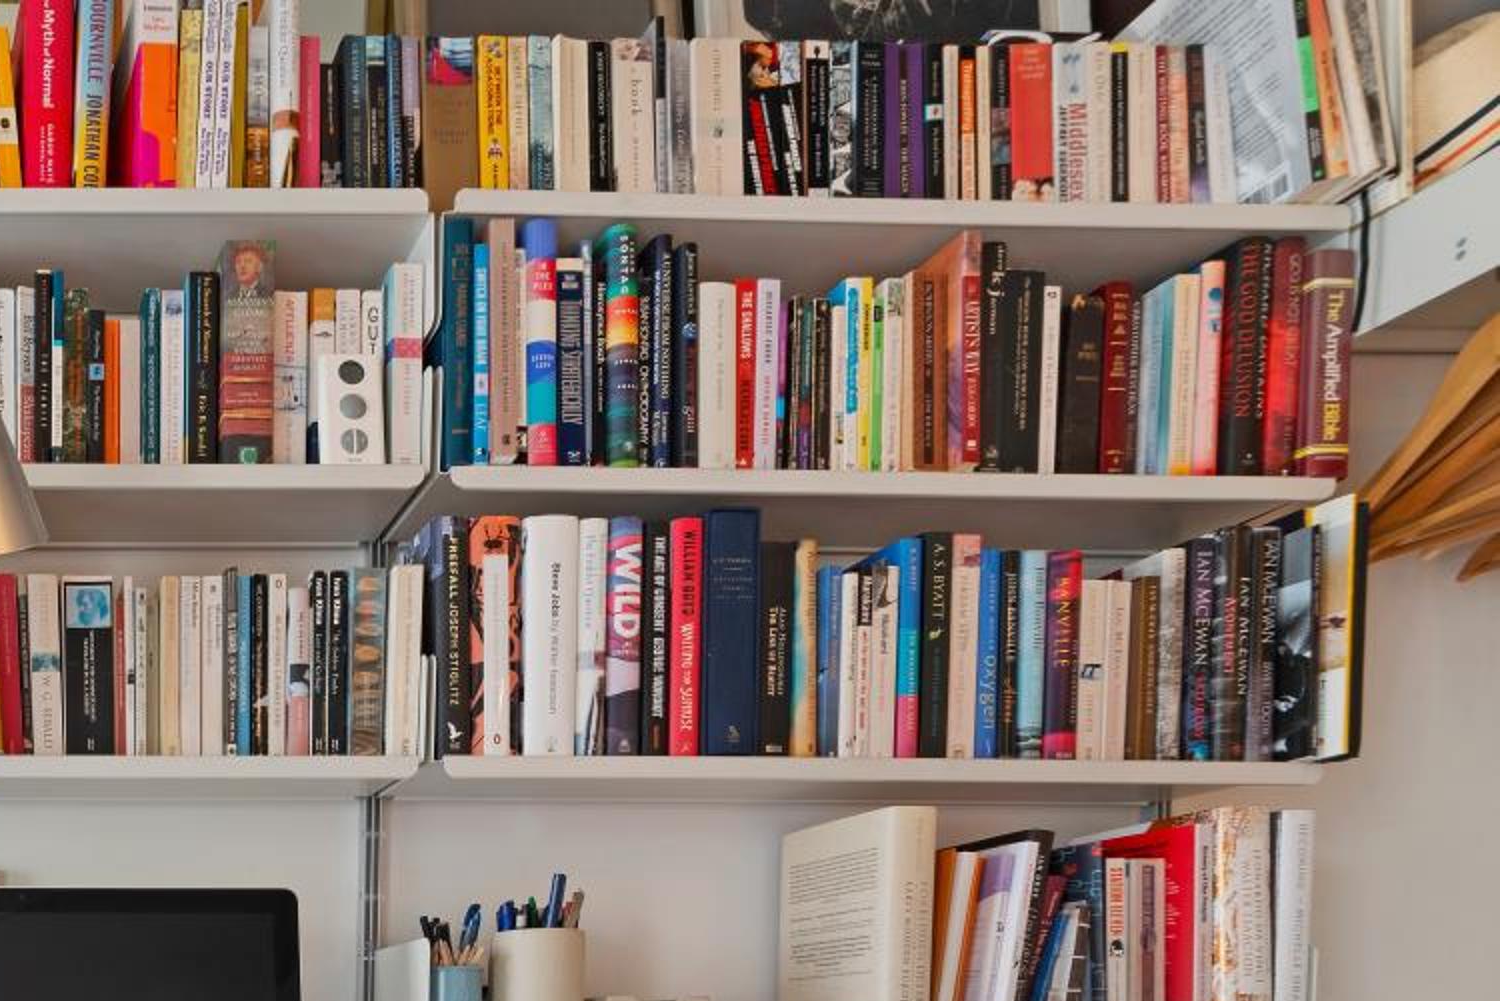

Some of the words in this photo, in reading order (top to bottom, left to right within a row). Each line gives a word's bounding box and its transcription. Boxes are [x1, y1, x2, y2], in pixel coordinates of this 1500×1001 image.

[41, 9, 56, 48] Myth
[42, 58, 55, 108] Normal
[83, 94, 103, 160] JONATHAN
[1058, 106, 1069, 148] JEFFREY
[1067, 103, 1088, 201] Middlesex
[619, 235, 630, 295] SONTAG
[1242, 243, 1259, 278] THE
[203, 289, 212, 316] Search
[476, 268, 487, 300] SWITCH
[661, 262, 672, 319] UNIVERSE
[741, 291, 753, 308] THE
[1239, 283, 1258, 321] GOD
[476, 302, 487, 313] ON
[560, 300, 582, 349] THINKING
[640, 296, 650, 323] SUSAN
[1326, 289, 1344, 321] The
[368, 307, 379, 354] GUT
[476, 315, 487, 337] YOUR
[640, 326, 650, 360] SONTAG
[661, 319, 672, 347] FROM
[739, 311, 752, 359] SHALLOWS
[476, 339, 487, 366] BRAIN
[1322, 324, 1343, 401] Amplified
[560, 350, 583, 425] STRATEGICALLY
[639, 366, 649, 383] ON
[661, 348, 671, 399] NOTHING
[1235, 329, 1256, 418] DELUSION
[639, 386, 649, 445] PHOTOGRAPHY
[1323, 402, 1341, 441] Bible
[655, 536, 666, 553] THE
[682, 529, 695, 583] WILLIAM
[933, 543, 944, 558] A.
[1264, 540, 1278, 567] IAN
[449, 537, 459, 599] FREEFALL
[550, 563, 561, 591] Steve
[653, 574, 665, 586] OF
[933, 559, 945, 571] S.
[1195, 551, 1213, 582] IAN
[332, 577, 341, 597] Ivan
[551, 593, 562, 618] Jobs
[613, 543, 642, 638] WILD
[932, 574, 944, 619] BYATT
[1005, 572, 1016, 604] JOHN
[1239, 576, 1251, 608] IAN
[449, 602, 459, 650] JOSEPH
[1005, 607, 1016, 662] BANVILLE
[1053, 576, 1072, 668] BANVILLE
[1223, 597, 1236, 673] ATONEMENT
[449, 652, 459, 706] STIGLITZ
[979, 654, 997, 730] oxygen
[681, 687, 693, 732] SUNRISE
[1109, 867, 1124, 905] STATION
[1109, 906, 1124, 938] ELEVEN
